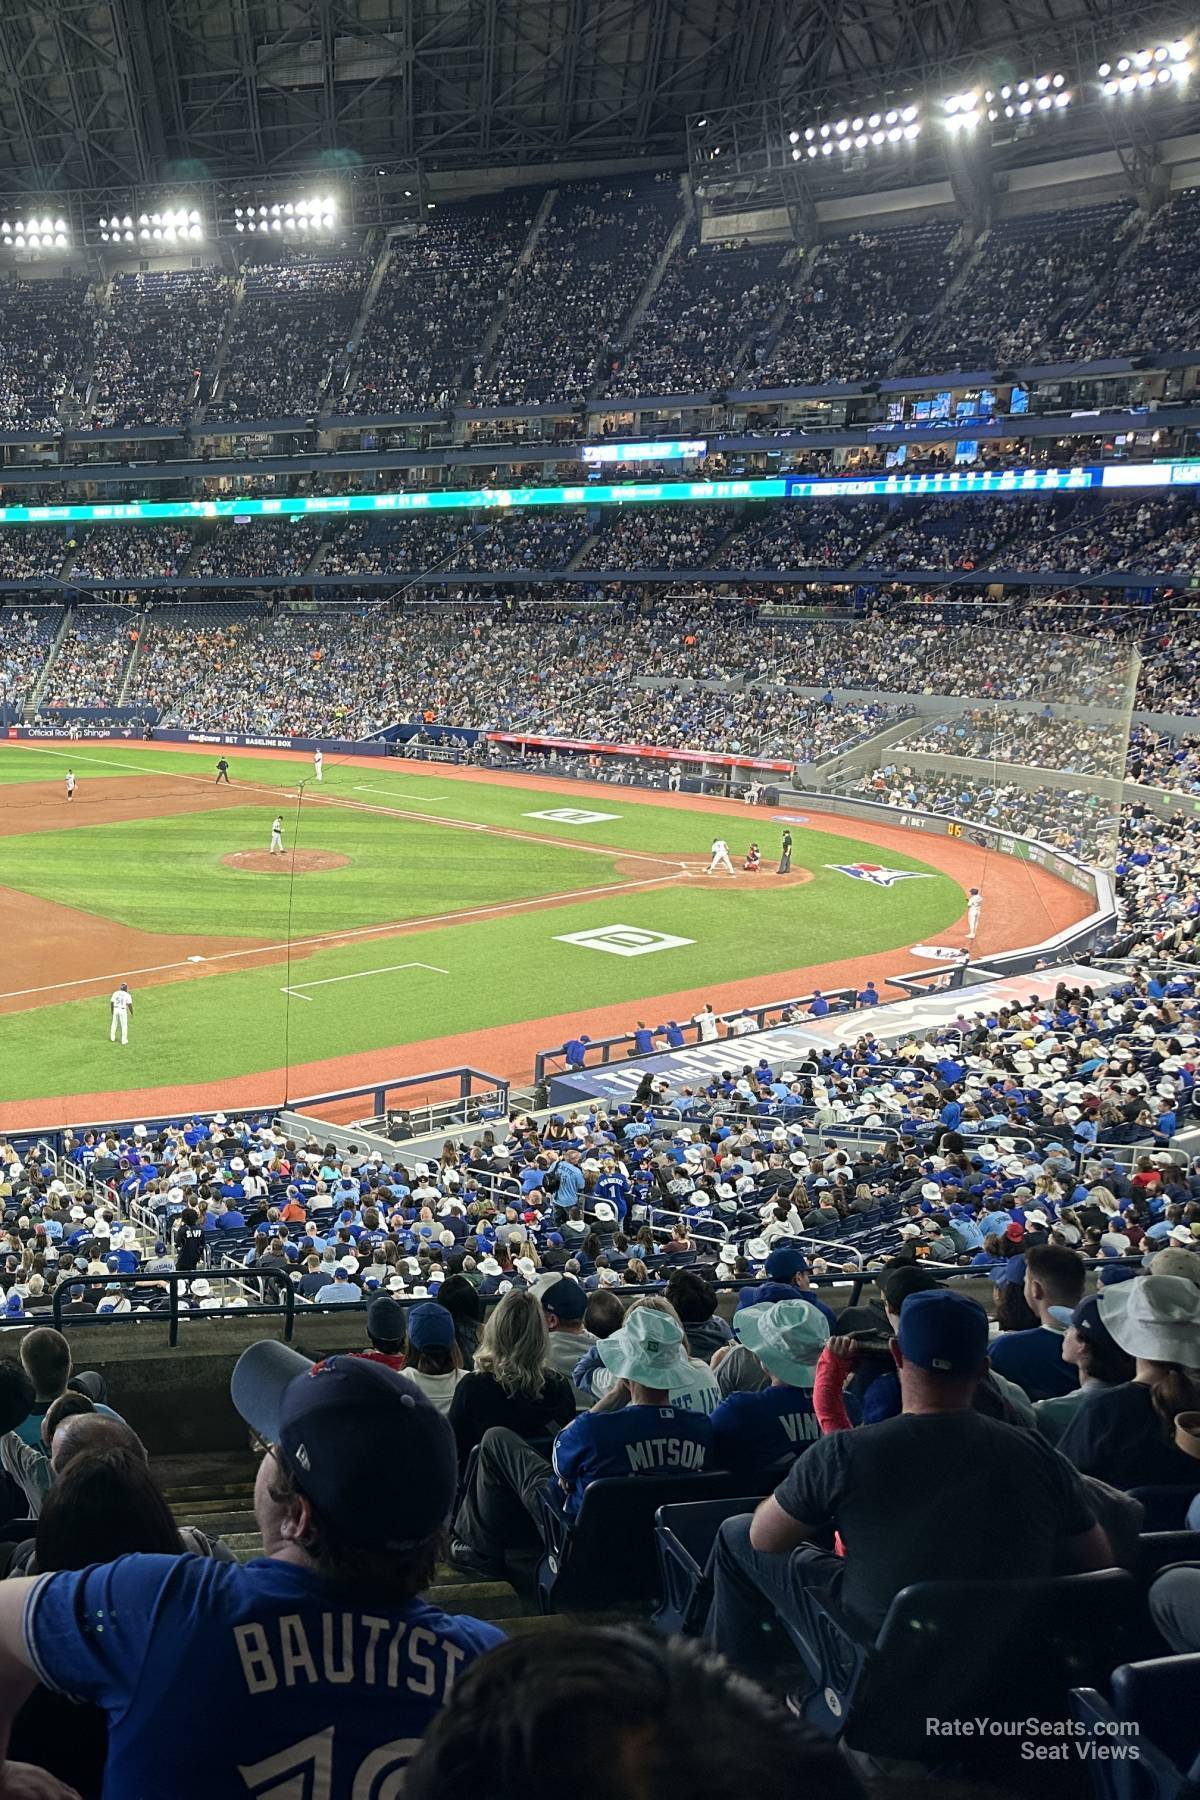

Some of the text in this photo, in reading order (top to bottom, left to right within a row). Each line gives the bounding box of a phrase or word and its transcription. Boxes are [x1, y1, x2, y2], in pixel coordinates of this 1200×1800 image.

[28, 728, 54, 737] Official
[83, 728, 111, 738] Shingle
[225, 736, 237, 744] BET
[245, 738, 276, 747] BASELINE
[276, 740, 292, 748] BOX
[911, 816, 926, 828] BET
[576, 931, 665, 948] TD
[625, 1438, 707, 1472] MITSON
[233, 1612, 465, 1704] BAUTIST
